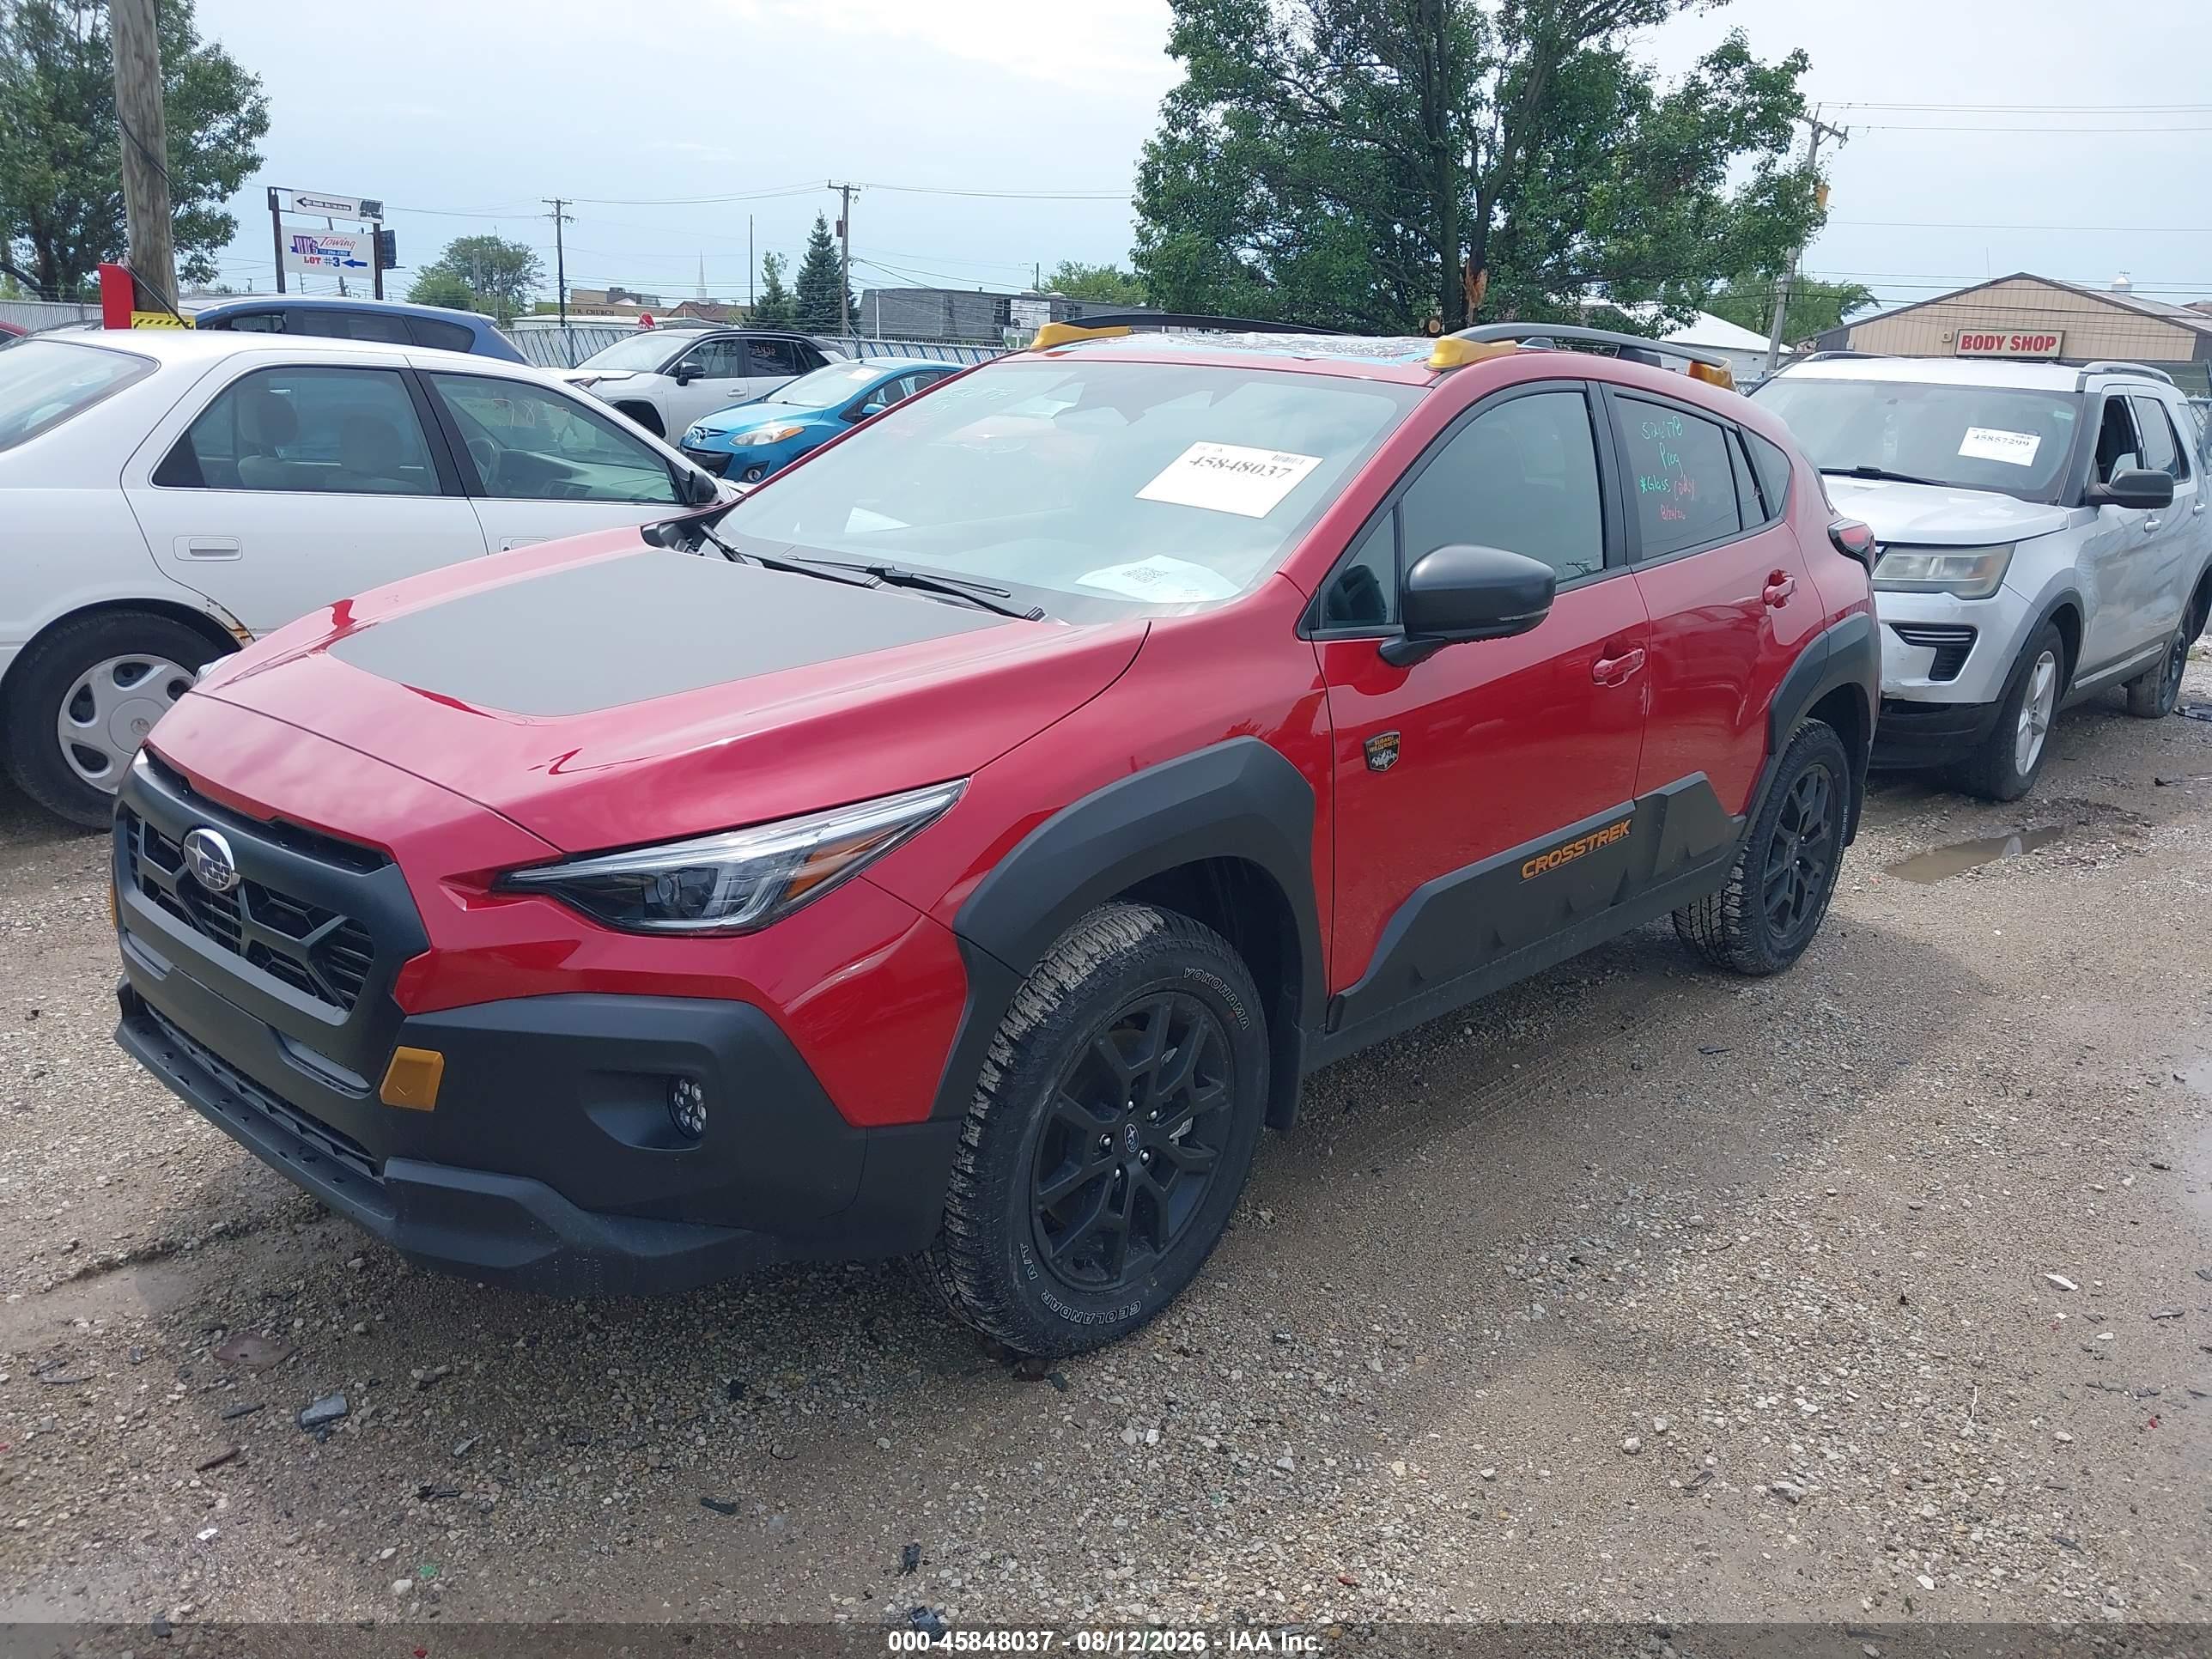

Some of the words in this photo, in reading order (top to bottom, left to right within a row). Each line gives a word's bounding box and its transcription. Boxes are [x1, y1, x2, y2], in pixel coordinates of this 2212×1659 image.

[317, 236, 356, 250] Towing
[303, 255, 321, 264] LOT
[323, 256, 341, 267] #3
[1960, 335, 2007, 350] BODY
[2009, 335, 2057, 352] SHOP
[1188, 455, 1295, 479] 45848037
[1521, 818, 1632, 879] CROSSTREK
[1183, 968, 1250, 1030] YOKOHAMA
[1019, 1243, 1038, 1280] A/T
[1041, 1289, 1141, 1324] GEOLANDAR
